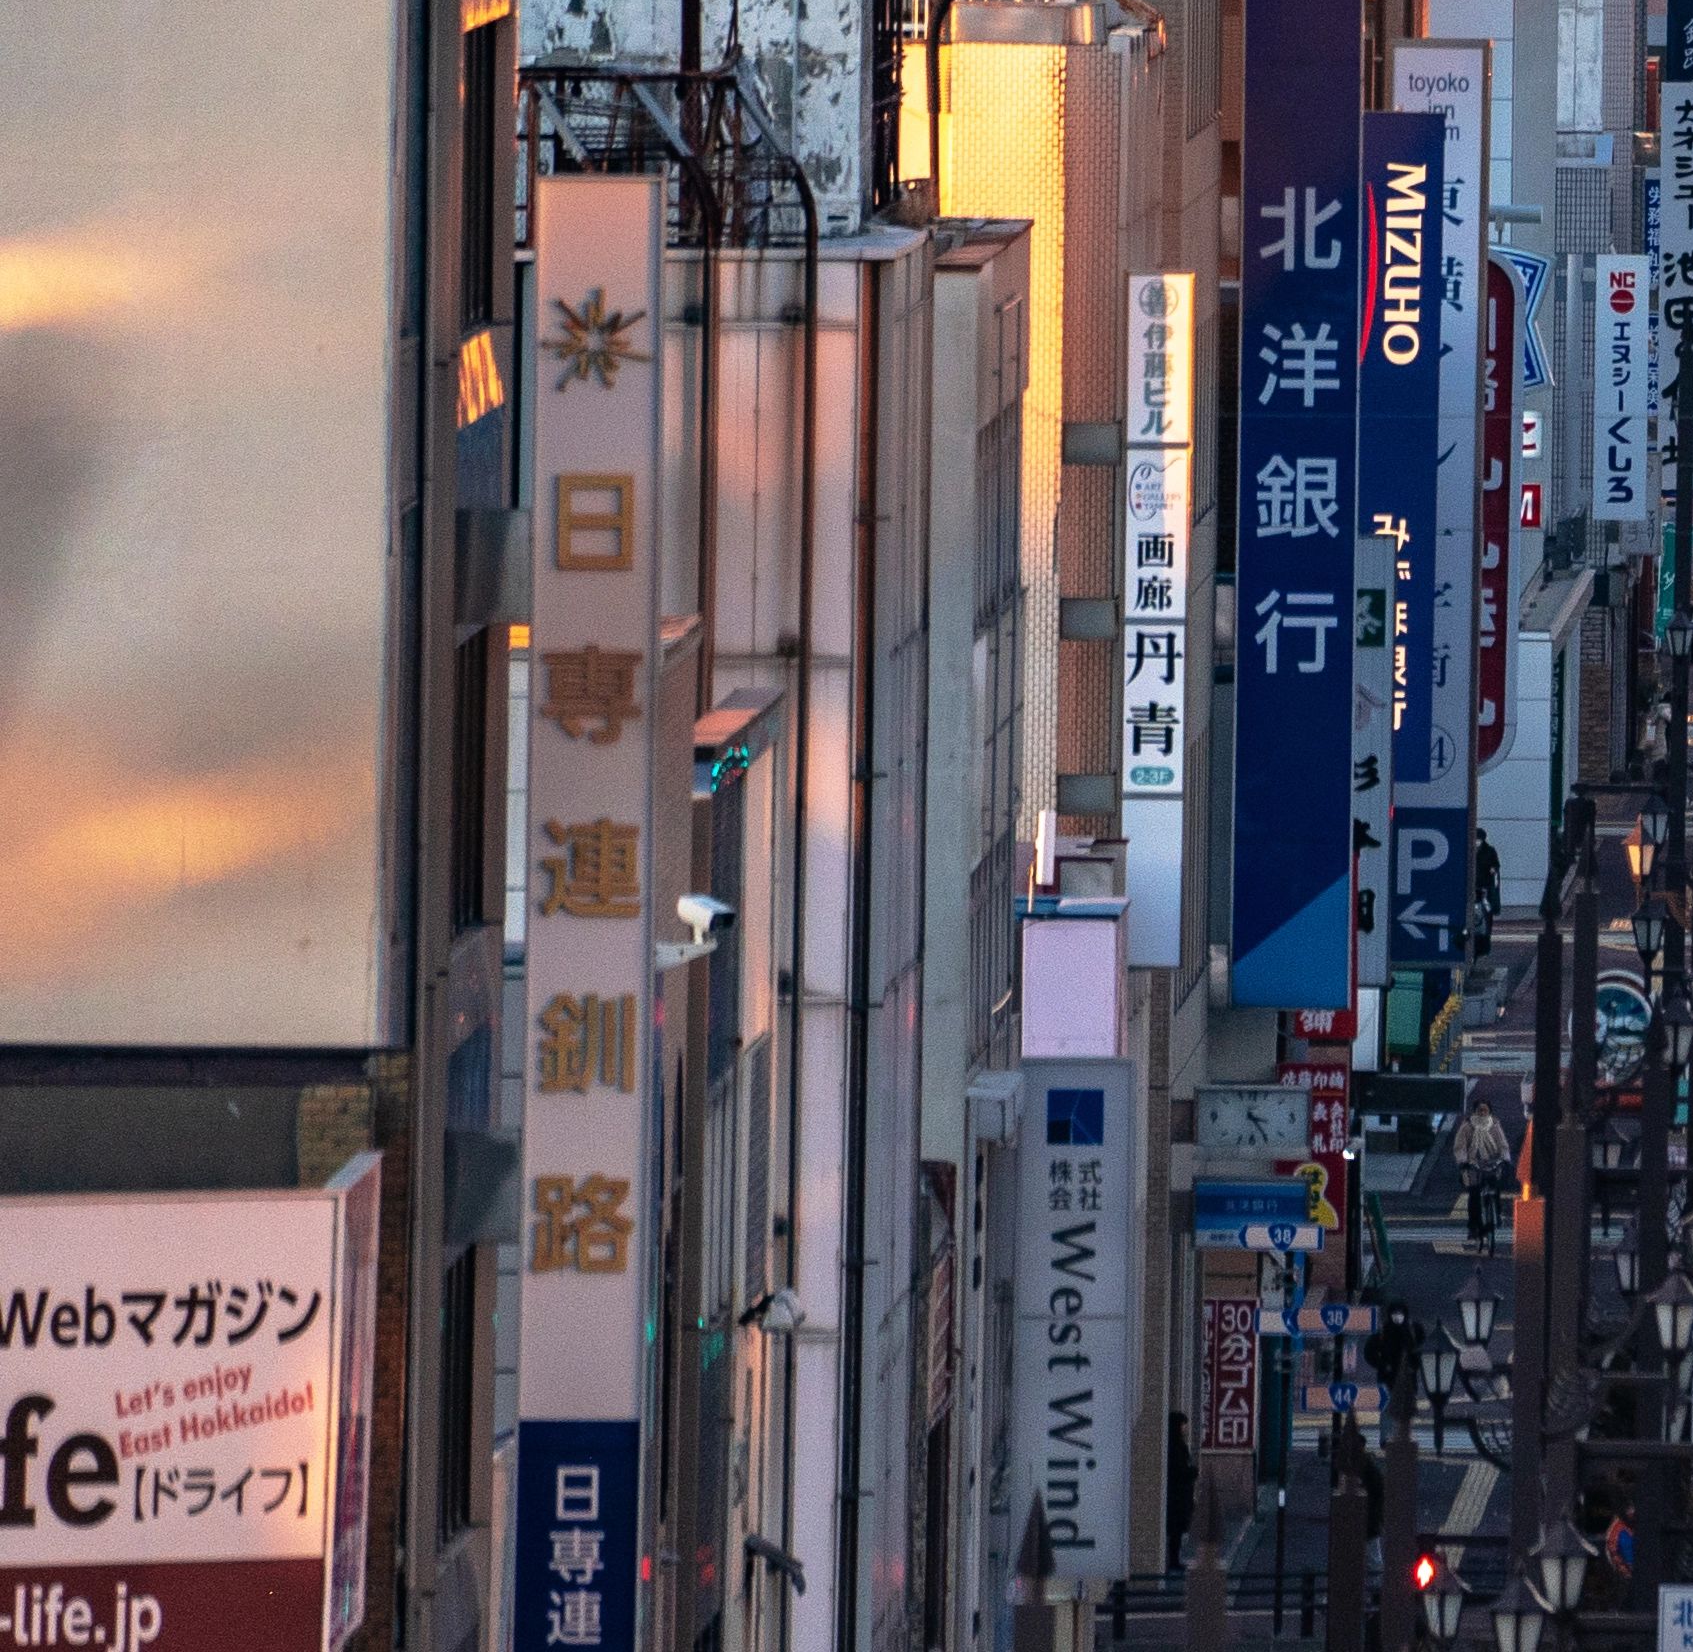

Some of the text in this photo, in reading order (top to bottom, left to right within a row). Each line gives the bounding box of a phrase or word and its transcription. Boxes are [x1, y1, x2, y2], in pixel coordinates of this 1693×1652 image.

[1409, 73, 1471, 95] toyoko
[1382, 161, 1428, 366] MIZUHO
[1609, 271, 1636, 289] NC
[1140, 322, 1175, 436] 伊藤ビル
[1606, 321, 1635, 504] エヌシーくしろ
[1254, 186, 1344, 674] 北洋銀行
[1134, 532, 1176, 612] 画廊
[1124, 629, 1183, 757] 丹青
[530, 472, 644, 1274] 日専連釧路
[1397, 827, 1449, 895] P
[1048, 1159, 1102, 1185] 株式
[1048, 1185, 1102, 1211] 会社
[1274, 1229, 1292, 1245] 38
[0, 1282, 322, 1349] Webマガジン
[115, 1362, 254, 1420] Let's enjoy
[1045, 1220, 1098, 1552] West Wind
[1218, 1303, 1253, 1446] 30分ゴム印
[1334, 1388, 1351, 1404] 44
[118, 1384, 315, 1462] East Hokkaido!
[545, 1464, 606, 1648] 日専連
